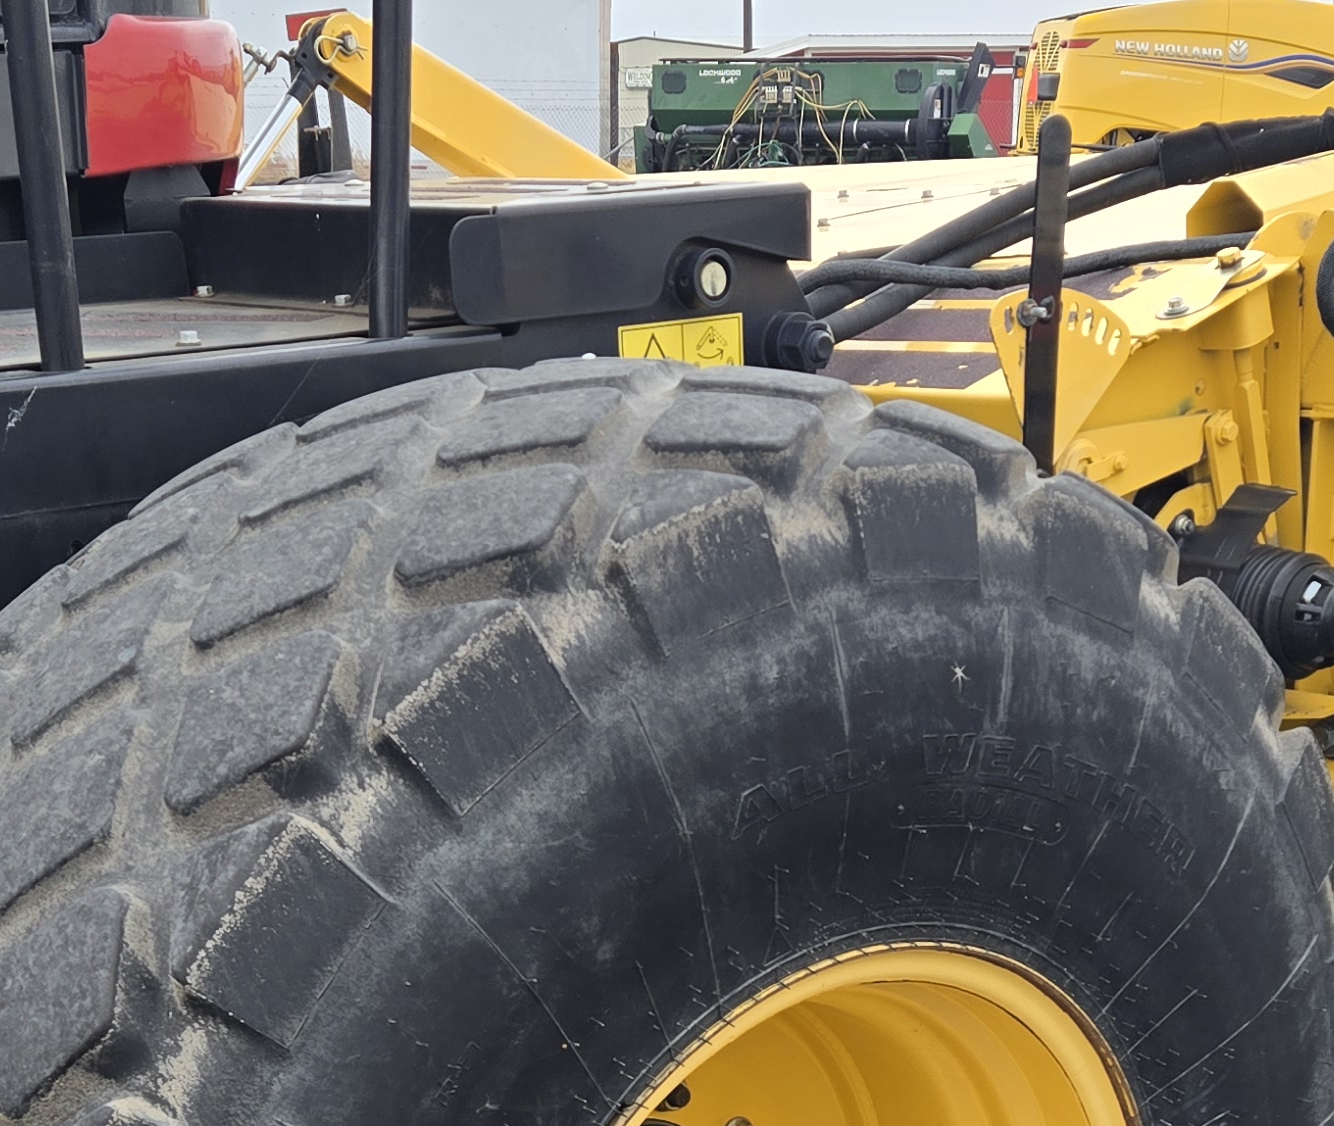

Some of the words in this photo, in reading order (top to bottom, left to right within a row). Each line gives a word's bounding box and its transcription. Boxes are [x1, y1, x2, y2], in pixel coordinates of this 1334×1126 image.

[1115, 39, 1150, 54] NEW
[1154, 43, 1223, 59] HOLLAND
[731, 748, 869, 842] ALL
[923, 731, 1197, 873] WEATHER
